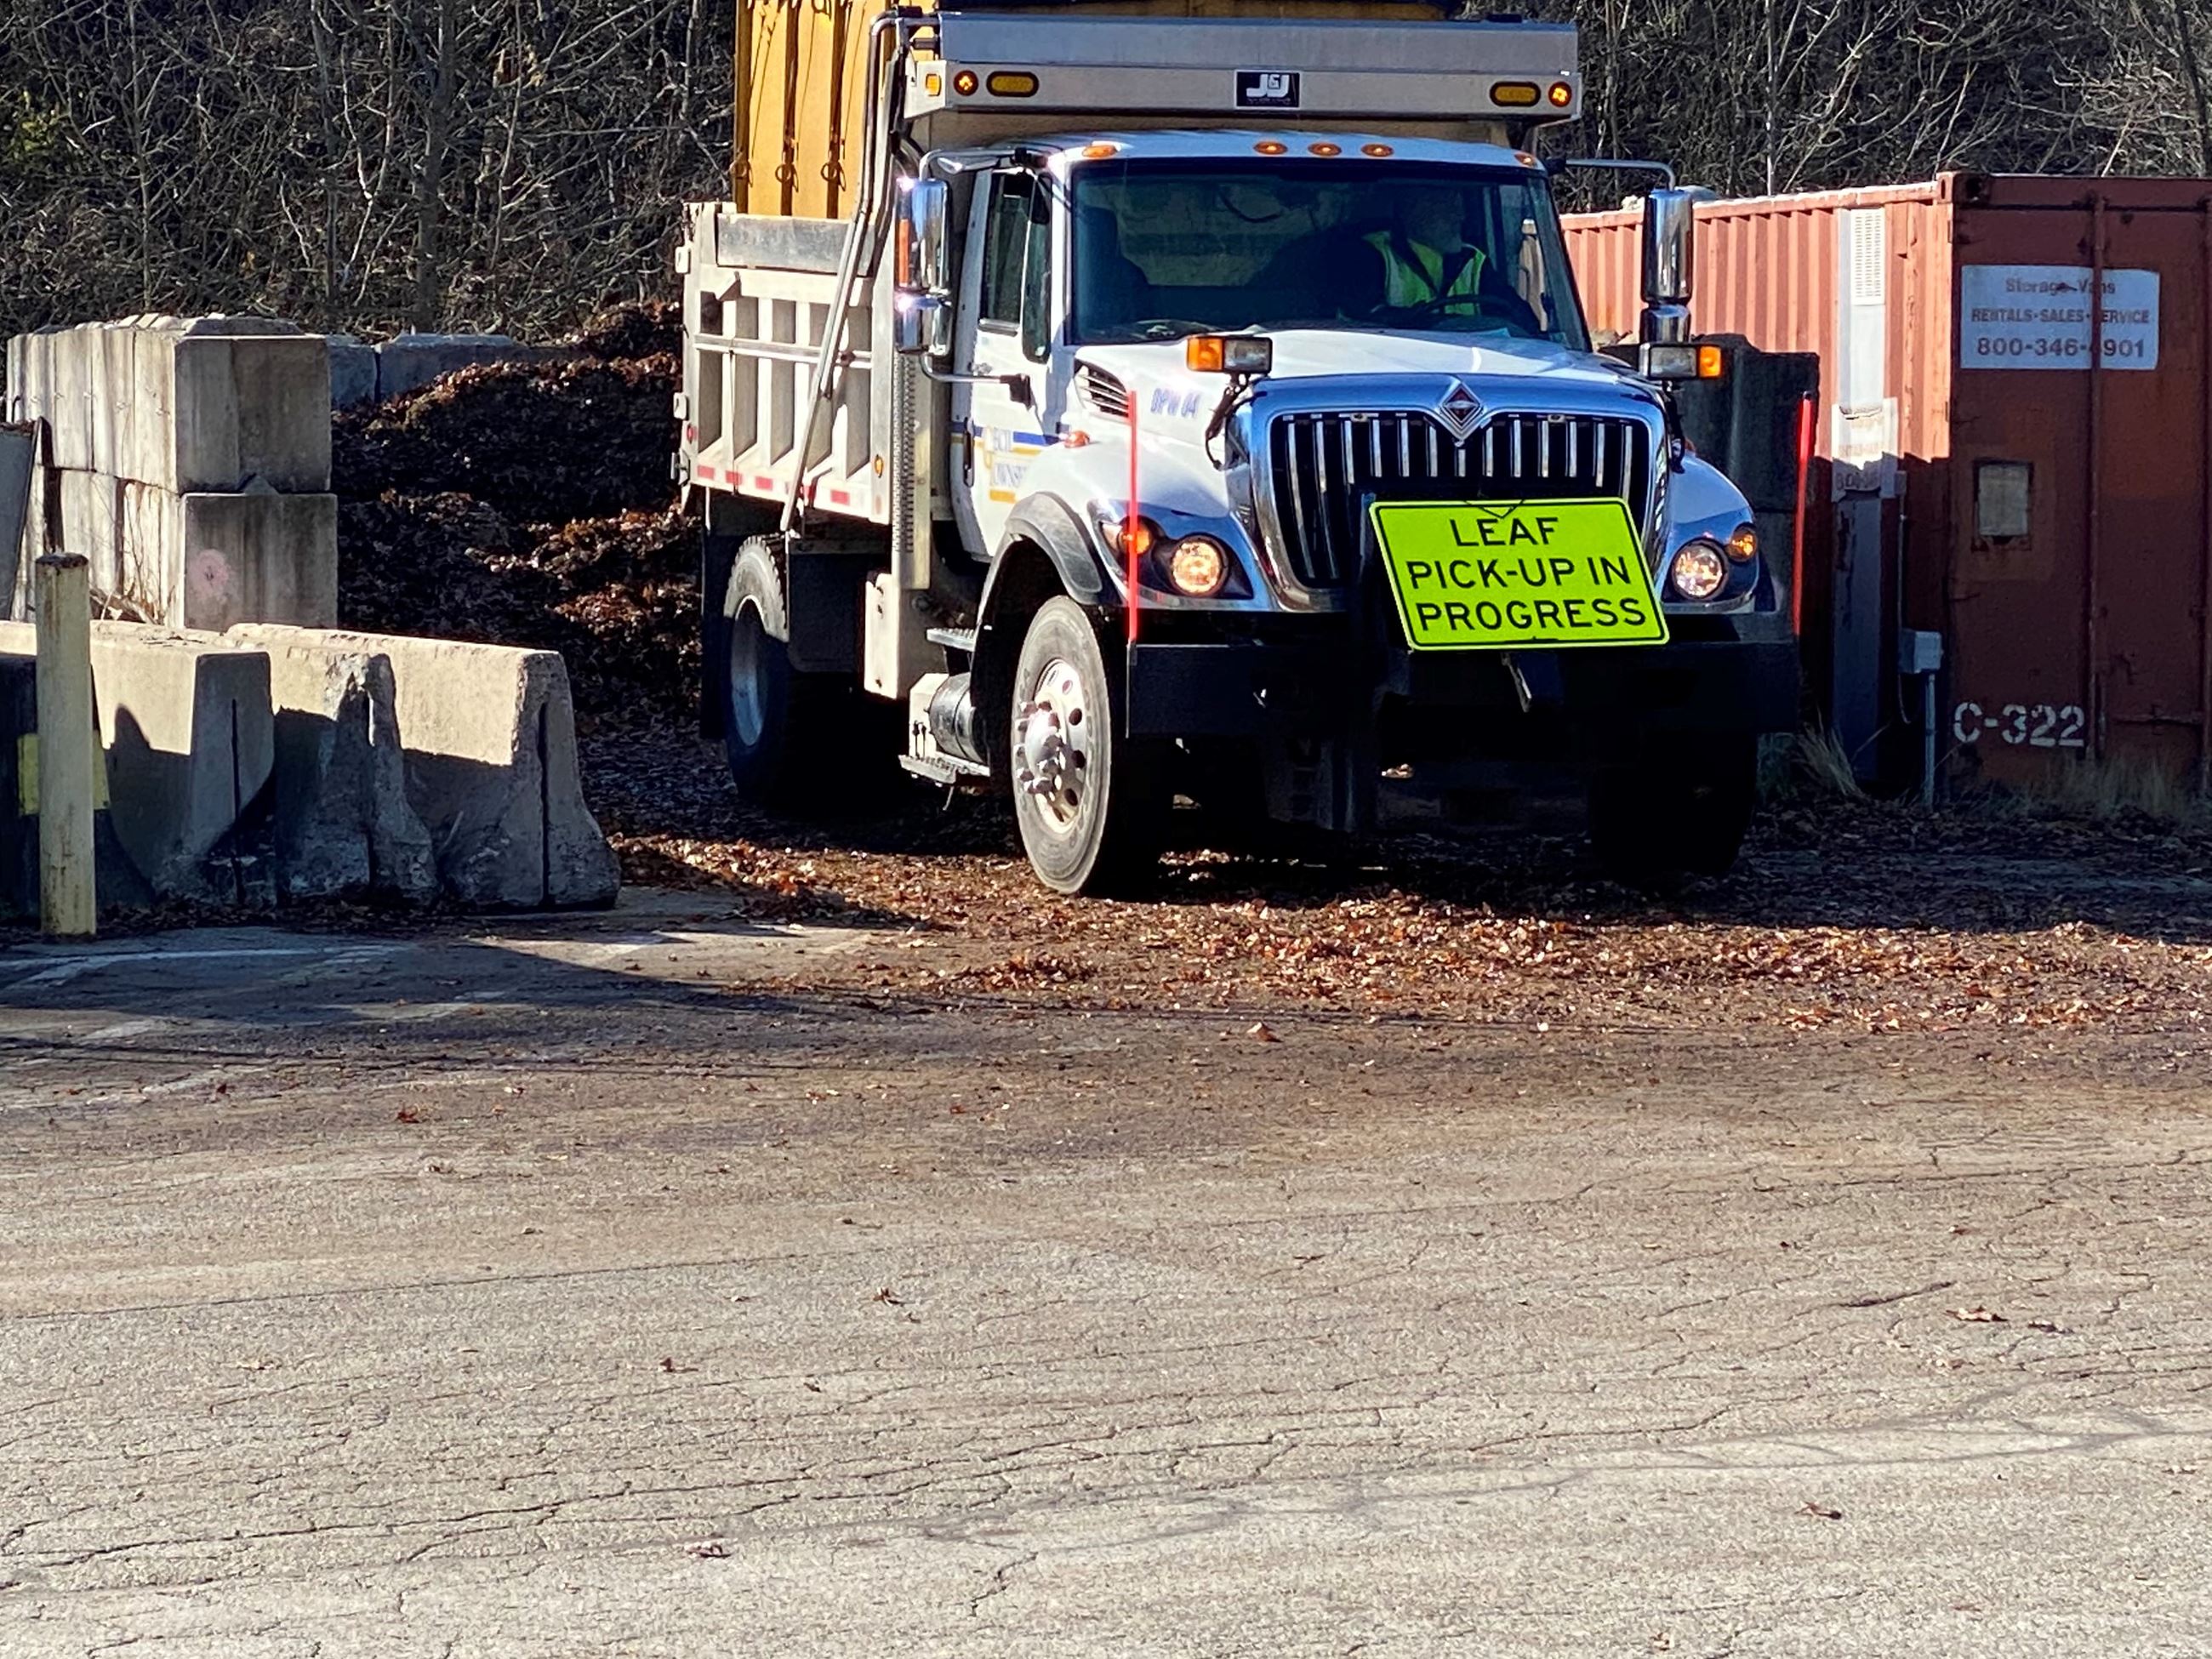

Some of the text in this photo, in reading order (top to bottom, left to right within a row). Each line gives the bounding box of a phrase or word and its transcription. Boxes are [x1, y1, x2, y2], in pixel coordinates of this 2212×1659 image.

[1977, 338, 2145, 358] 800-346-901
[1449, 517, 1559, 547] LEAF
[1406, 556, 1633, 590] PICK-UP IN
[1416, 598, 1647, 631] PROGRESS
[1953, 702, 2085, 747] C-322
